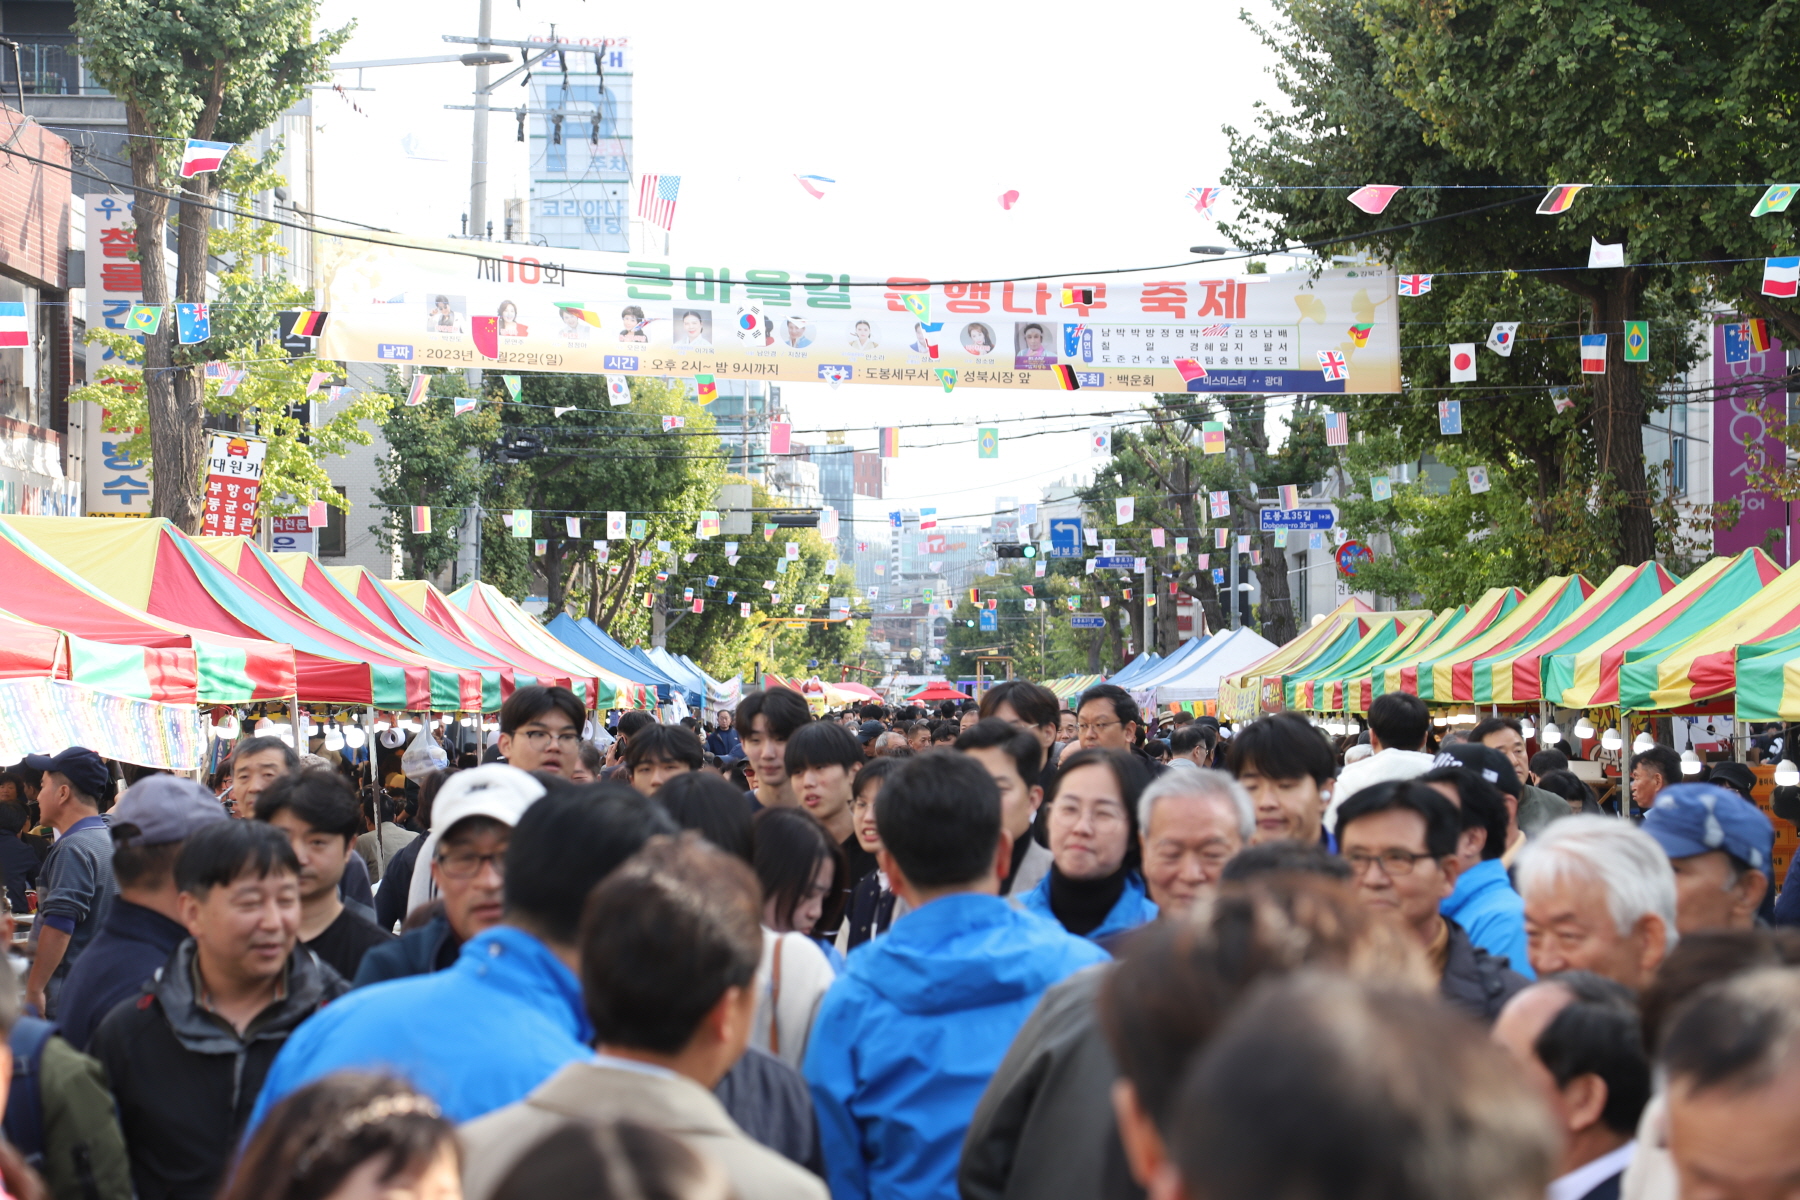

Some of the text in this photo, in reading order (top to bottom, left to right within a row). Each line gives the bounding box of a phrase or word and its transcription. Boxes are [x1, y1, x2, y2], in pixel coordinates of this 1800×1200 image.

[94, 197, 135, 220] 우
[542, 200, 623, 217] 코리아나
[584, 217, 621, 234] 빌딩
[1140, 278, 1247, 319] 축제
[382, 344, 564, 367] 날짜 2023년 월22일(일)
[608, 356, 635, 369] 시간
[651, 359, 677, 372] 오후
[733, 363, 780, 376] 9시까지
[866, 368, 929, 381] 도봉세무서
[963, 370, 1015, 384] 성북시장
[1018, 371, 1032, 384] 앞
[1117, 374, 1154, 387] 백운회
[1202, 375, 1283, 387] 미스미스터 광대
[212, 458, 260, 478] 대원카
[1263, 511, 1311, 521] 도봉로35길
